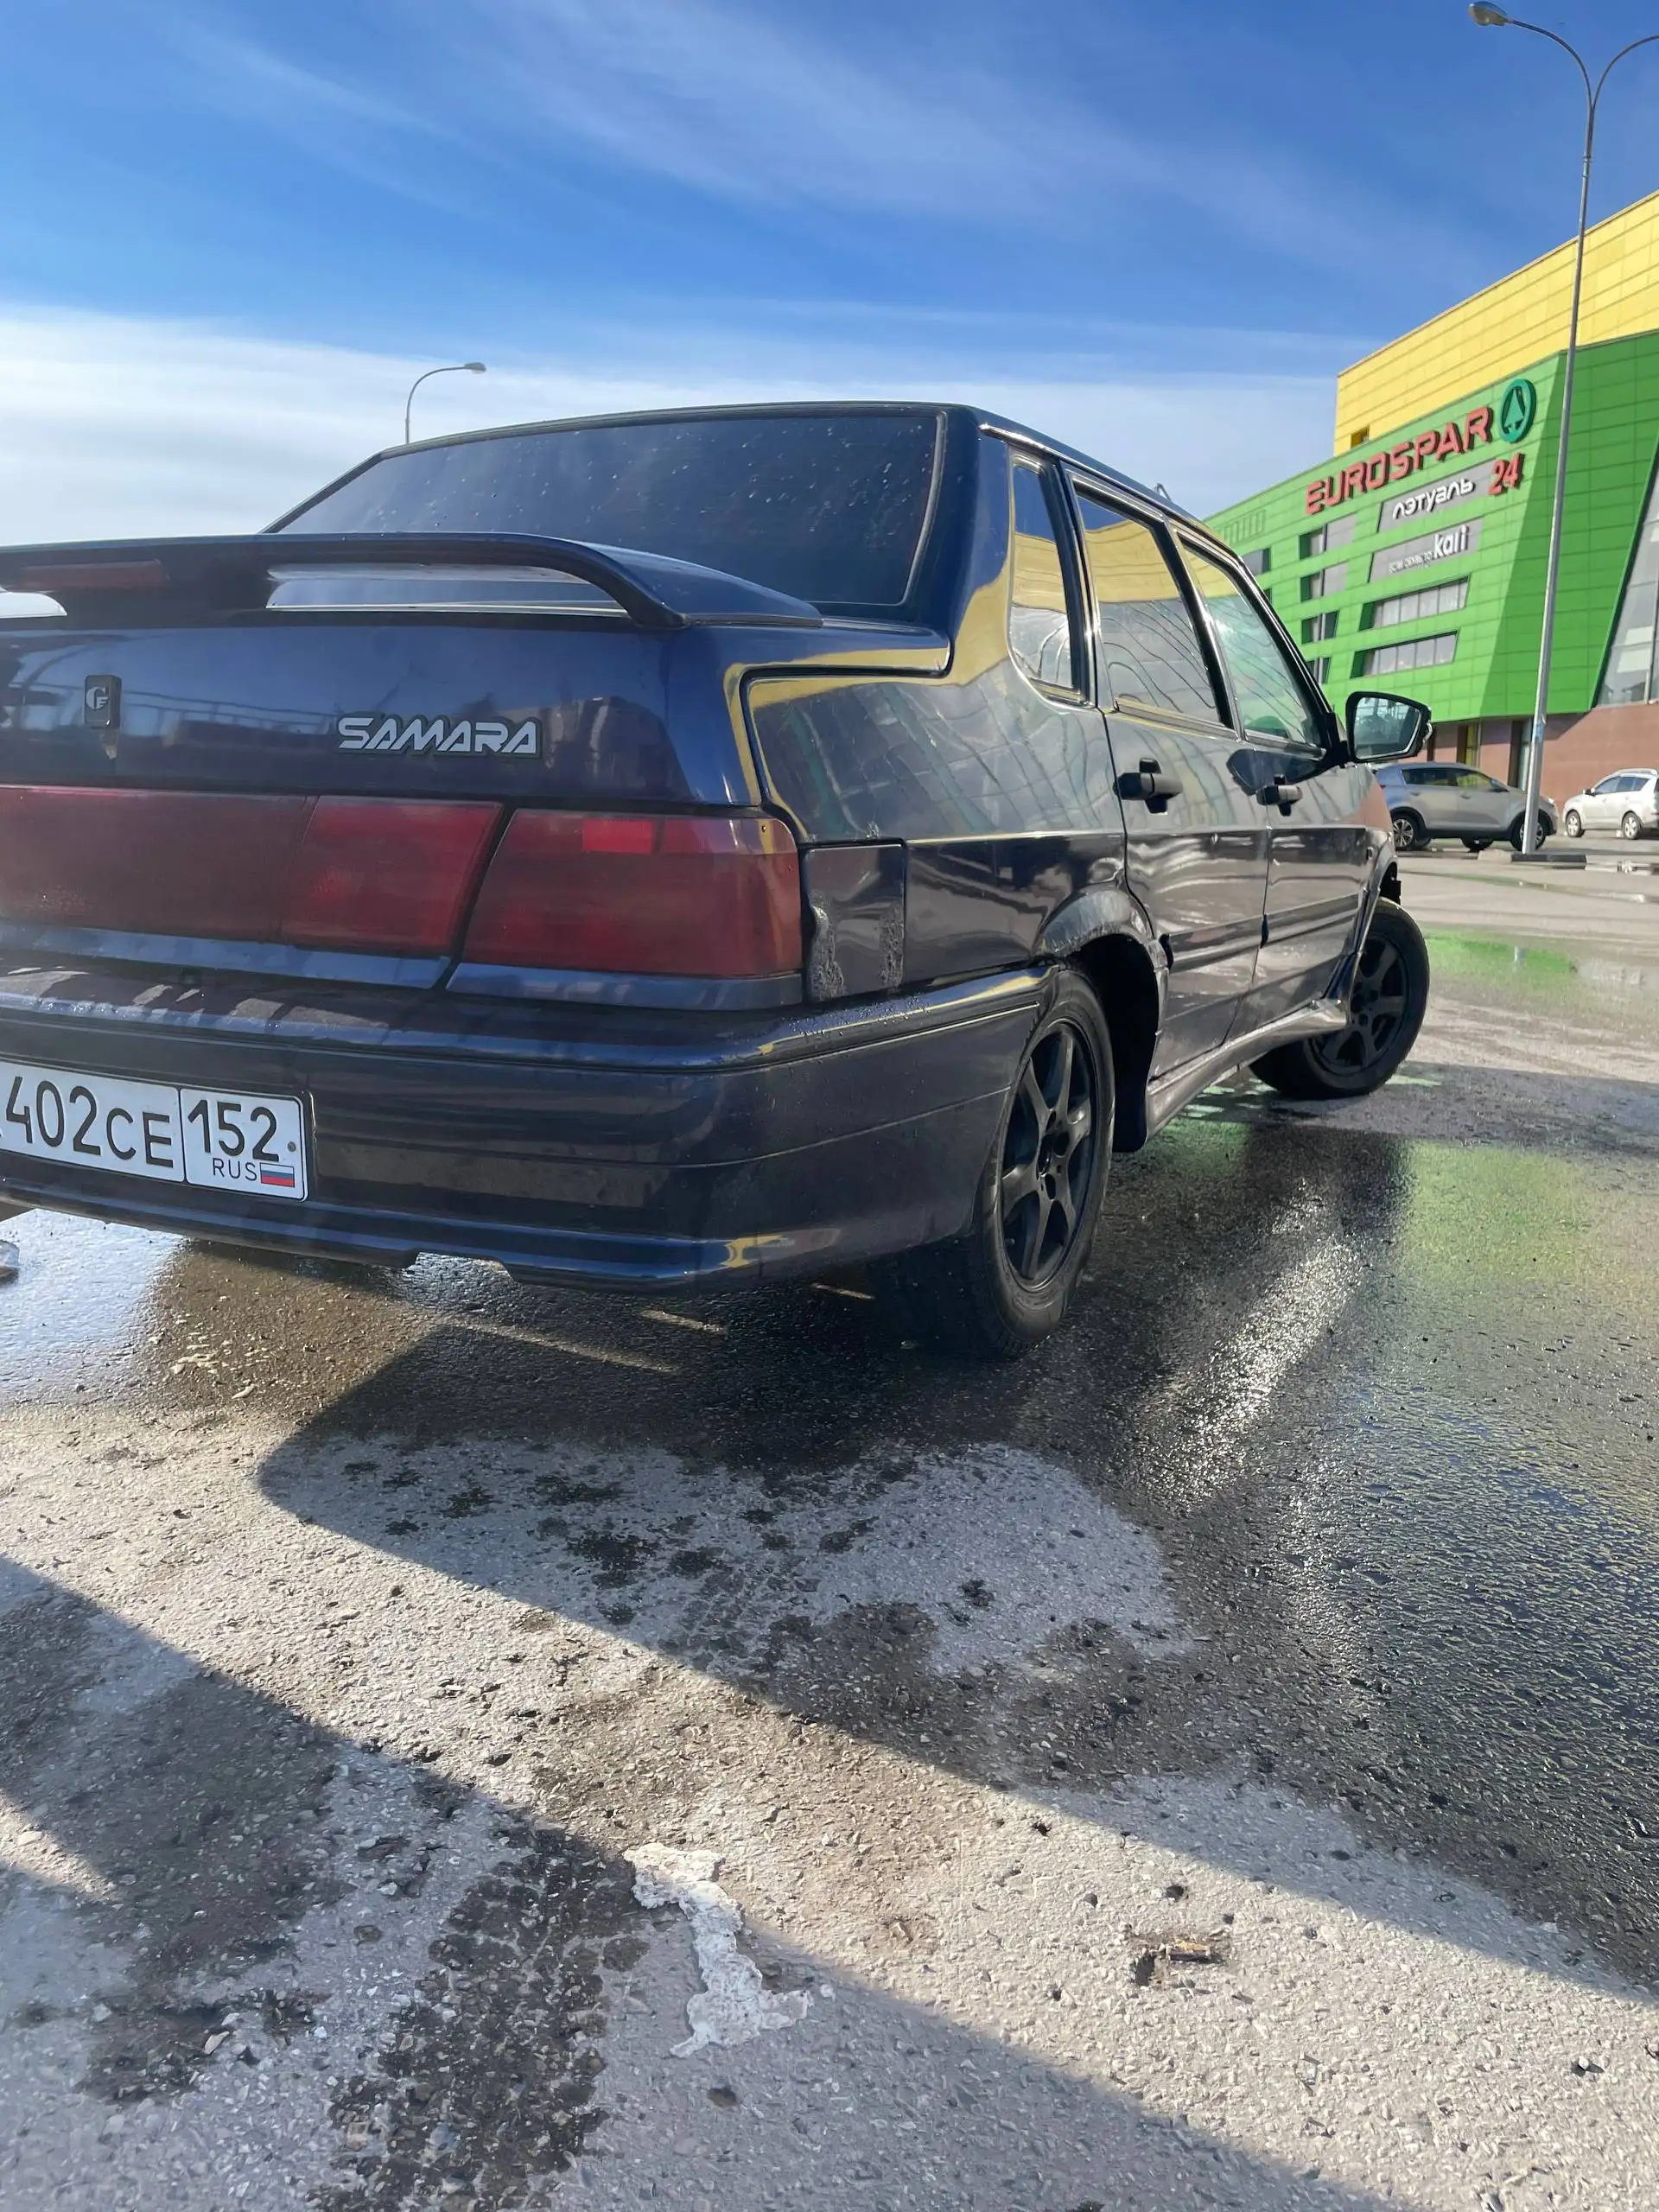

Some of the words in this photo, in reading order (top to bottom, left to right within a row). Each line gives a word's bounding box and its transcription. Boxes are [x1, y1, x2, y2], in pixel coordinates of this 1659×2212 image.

[1306, 406, 1493, 515] EUROSPAR
[1489, 453, 1524, 495] 24
[338, 717, 537, 754] SAMARA
[0, 1076, 174, 1168] 402CE
[188, 1099, 280, 1163] 152
[213, 1158, 257, 1181] RUS
